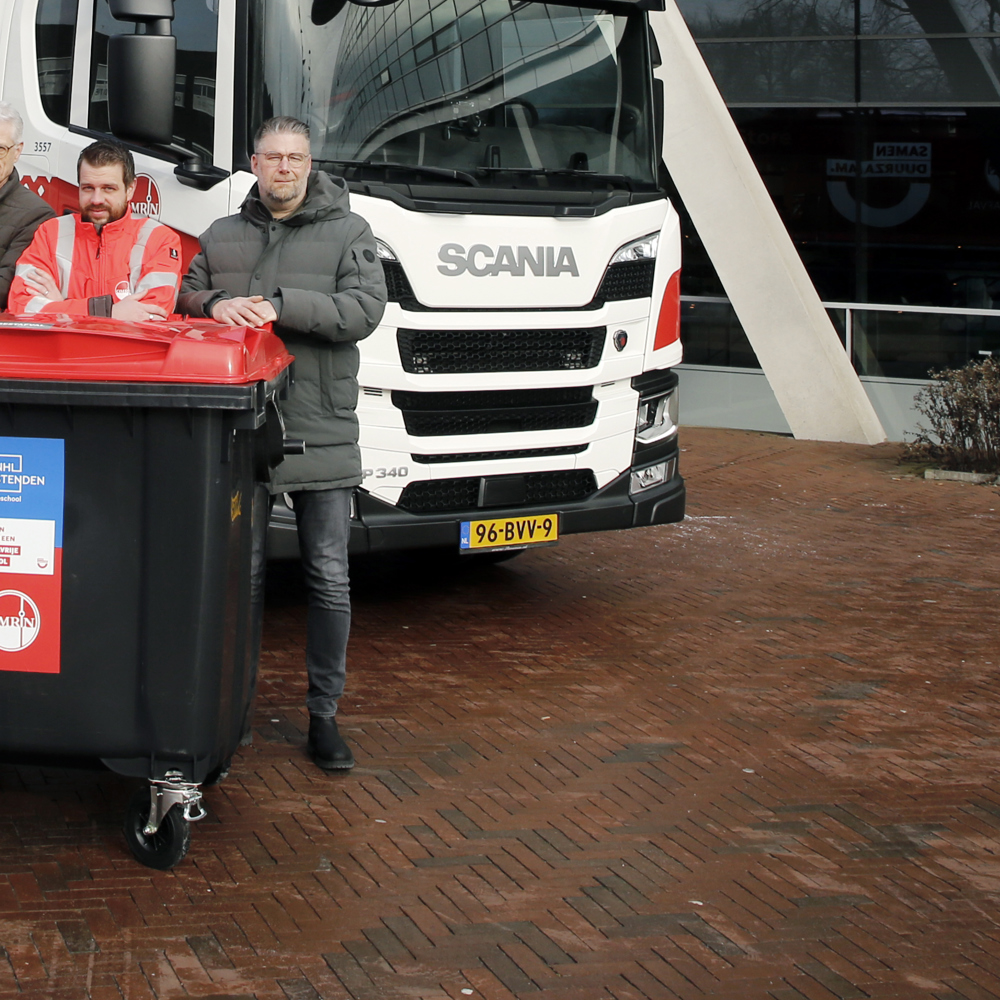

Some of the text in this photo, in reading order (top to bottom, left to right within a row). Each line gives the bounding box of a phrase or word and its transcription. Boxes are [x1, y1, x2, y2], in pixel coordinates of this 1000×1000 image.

[34, 141, 52, 153] 3557
[131, 202, 159, 216] MRIN
[436, 242, 580, 278] SCANIA
[375, 466, 409, 479] 340
[461, 518, 553, 545] NL 96-BVV-9
